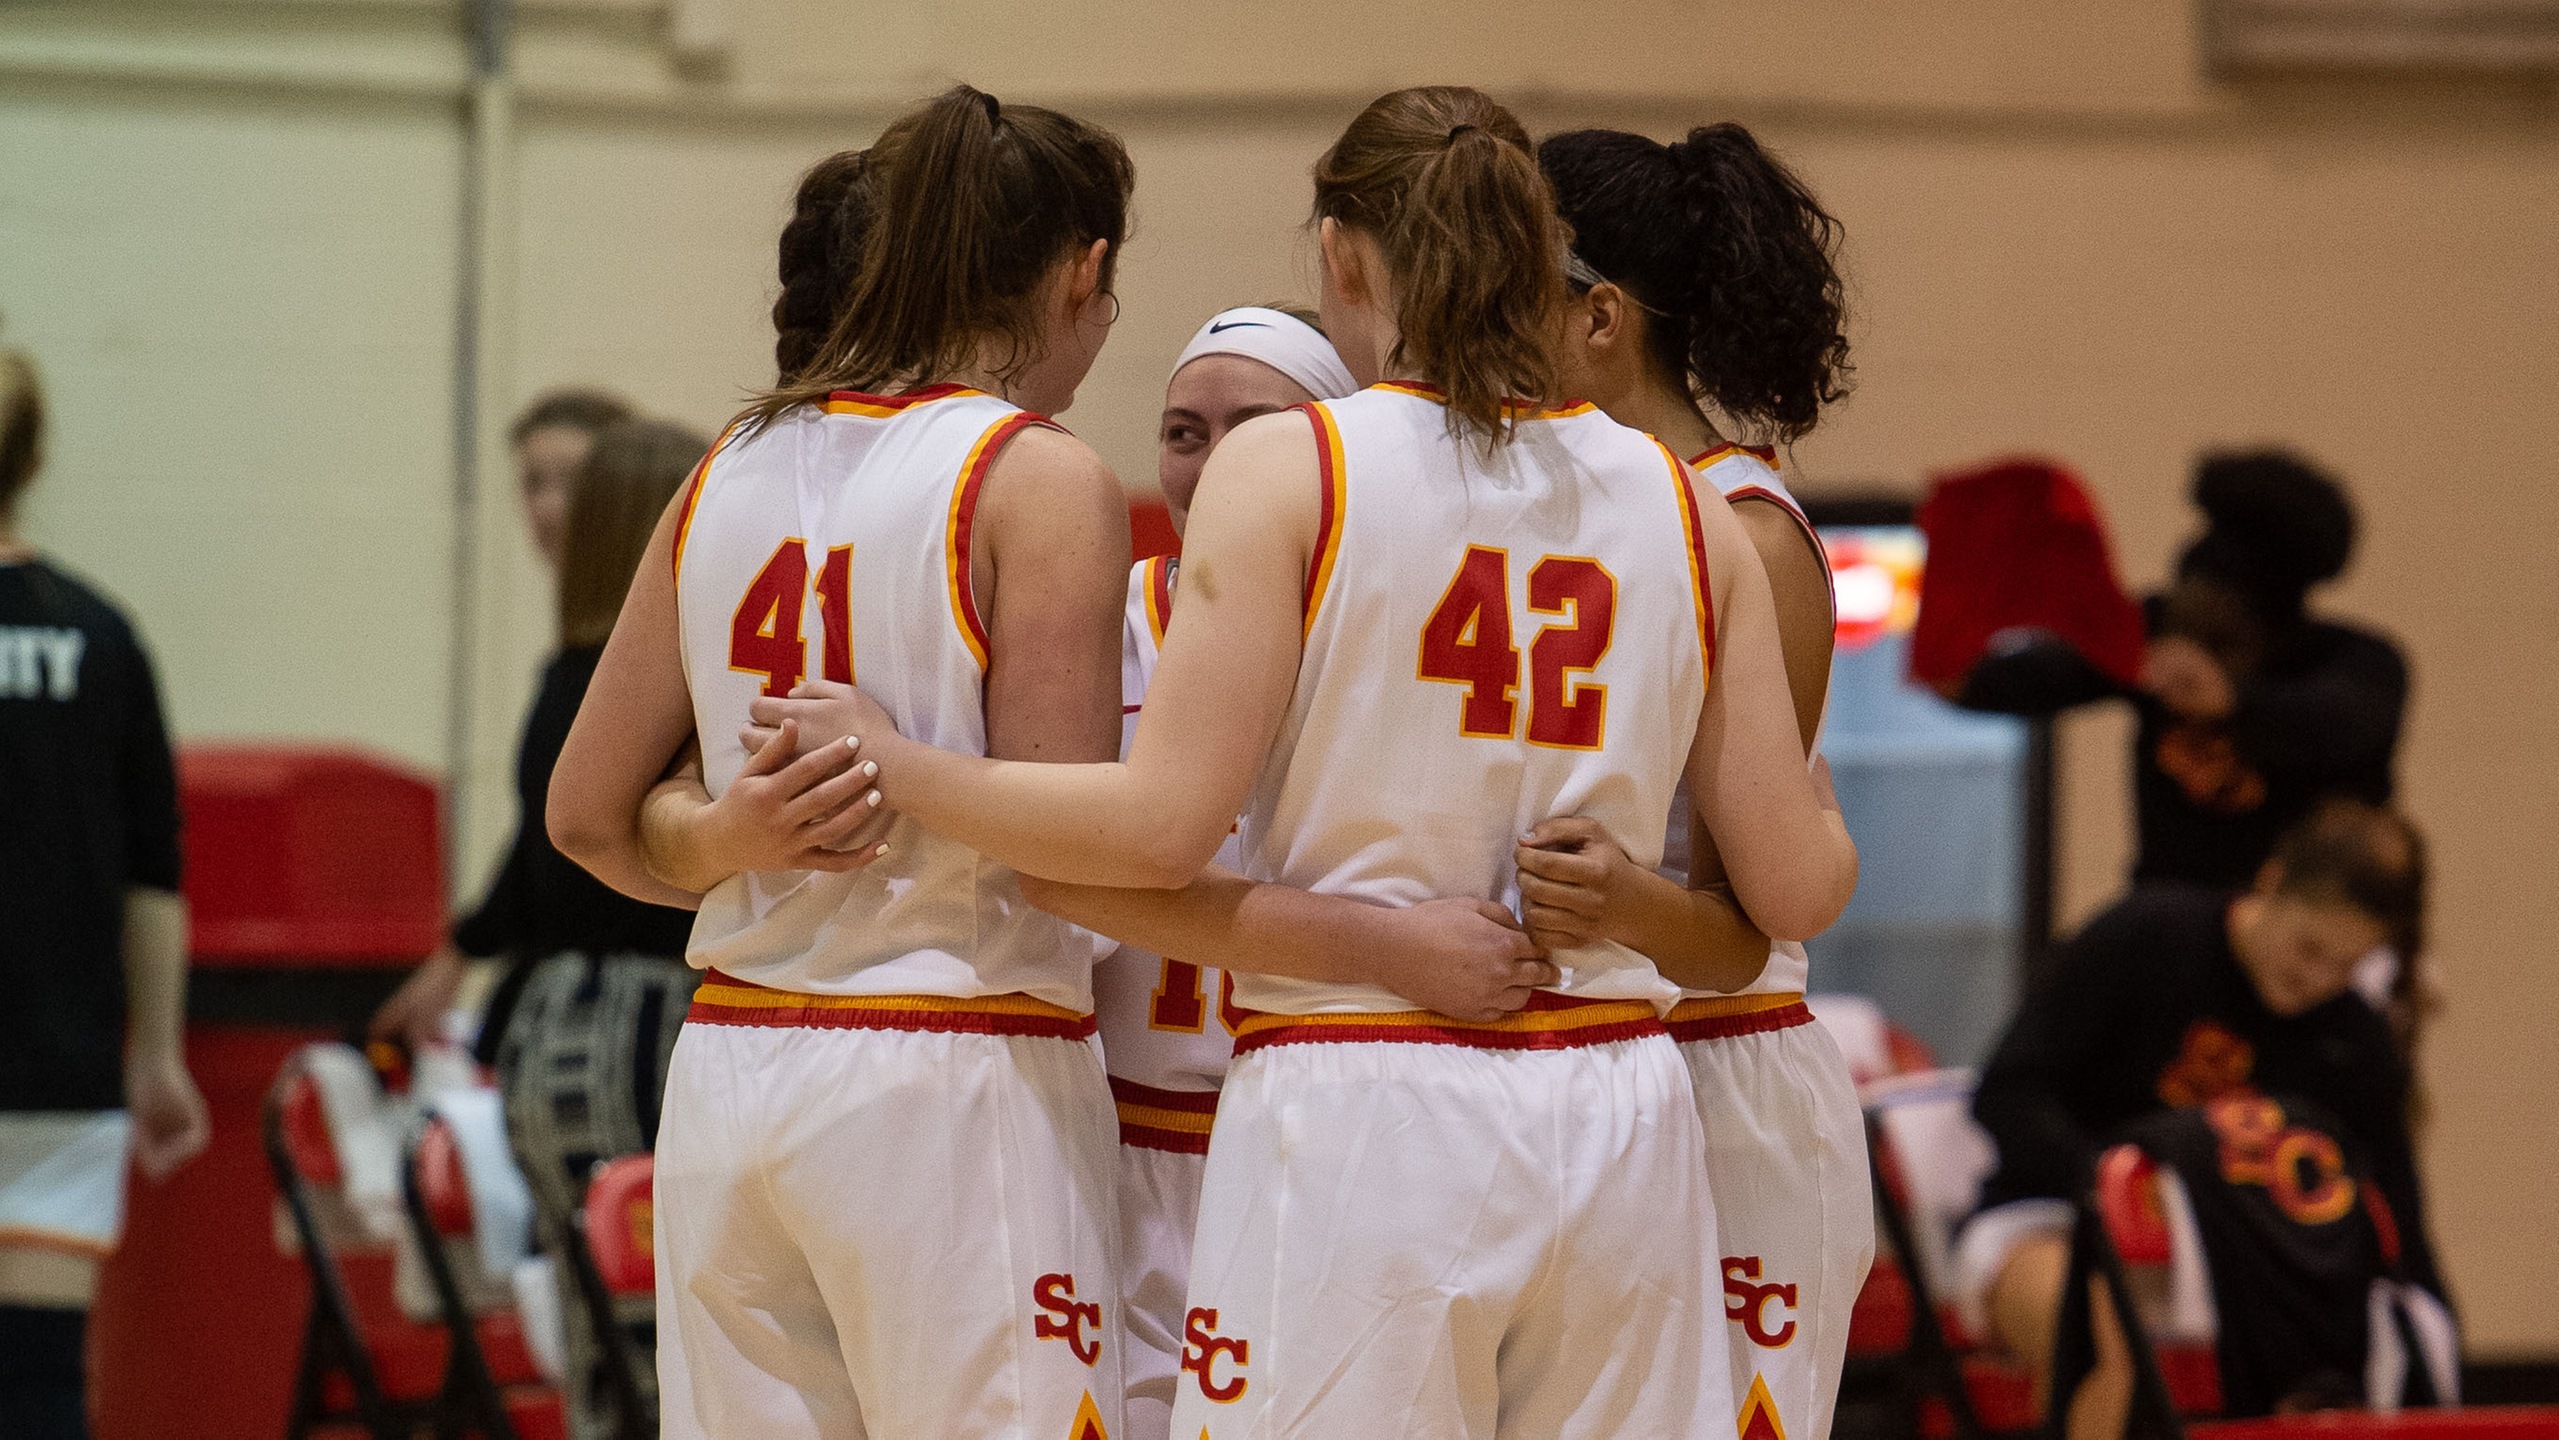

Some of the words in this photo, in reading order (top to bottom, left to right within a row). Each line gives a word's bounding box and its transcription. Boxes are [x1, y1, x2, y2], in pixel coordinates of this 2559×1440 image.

[728, 536, 856, 698] 41
[1416, 543, 1618, 751] 42
[1033, 1273, 1101, 1367] SC
[1720, 1256, 1798, 1349] SC
[1180, 1306, 1249, 1404] SC
